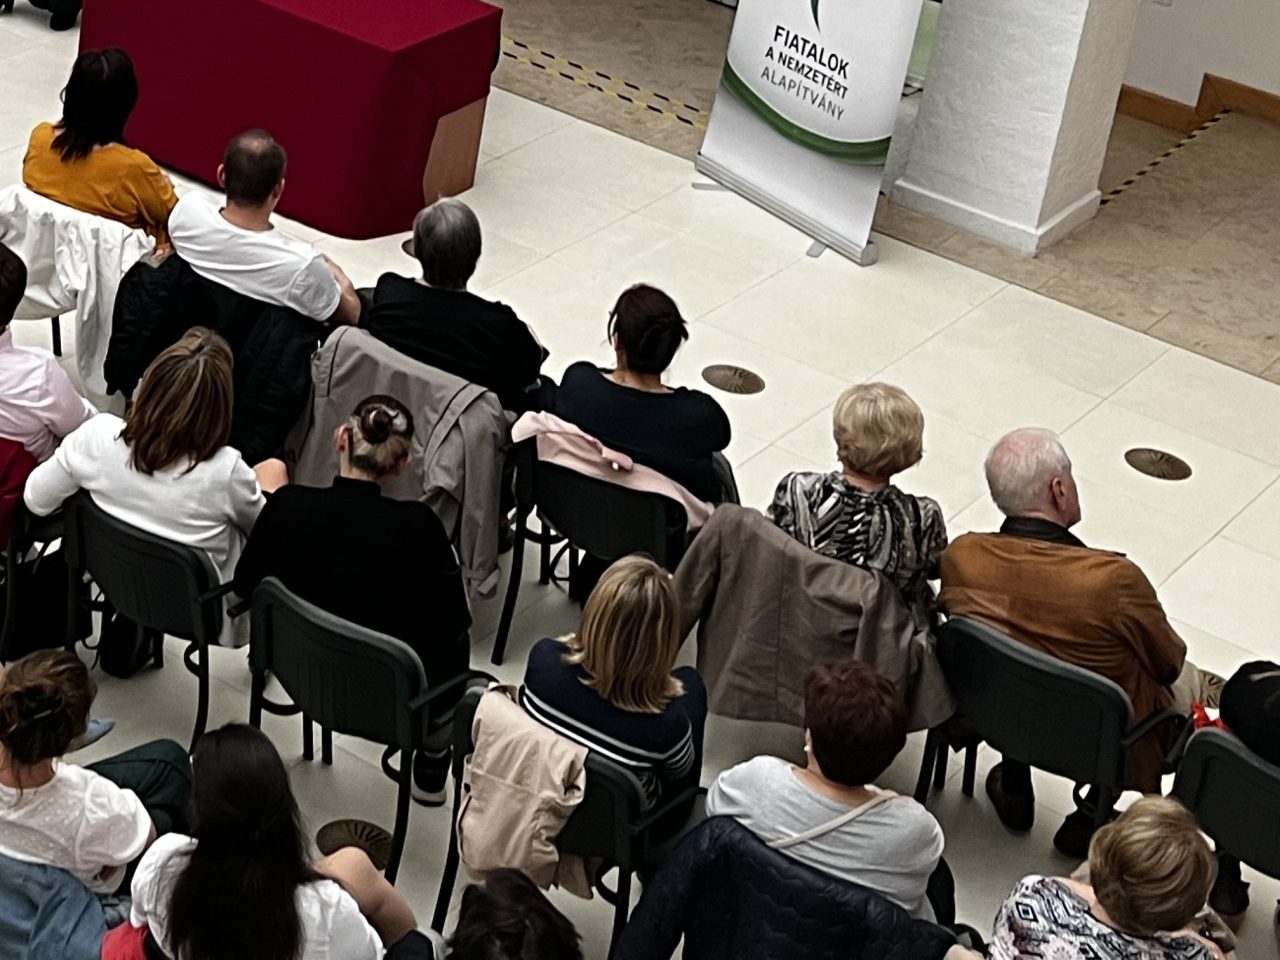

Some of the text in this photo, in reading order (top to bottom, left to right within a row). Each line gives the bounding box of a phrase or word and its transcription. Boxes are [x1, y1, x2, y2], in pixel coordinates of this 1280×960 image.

[765, 46, 848, 99] A NEMZETÉRT
[774, 25, 849, 79] FIATALOK
[761, 66, 845, 120] ALAPÍTVÁNY
